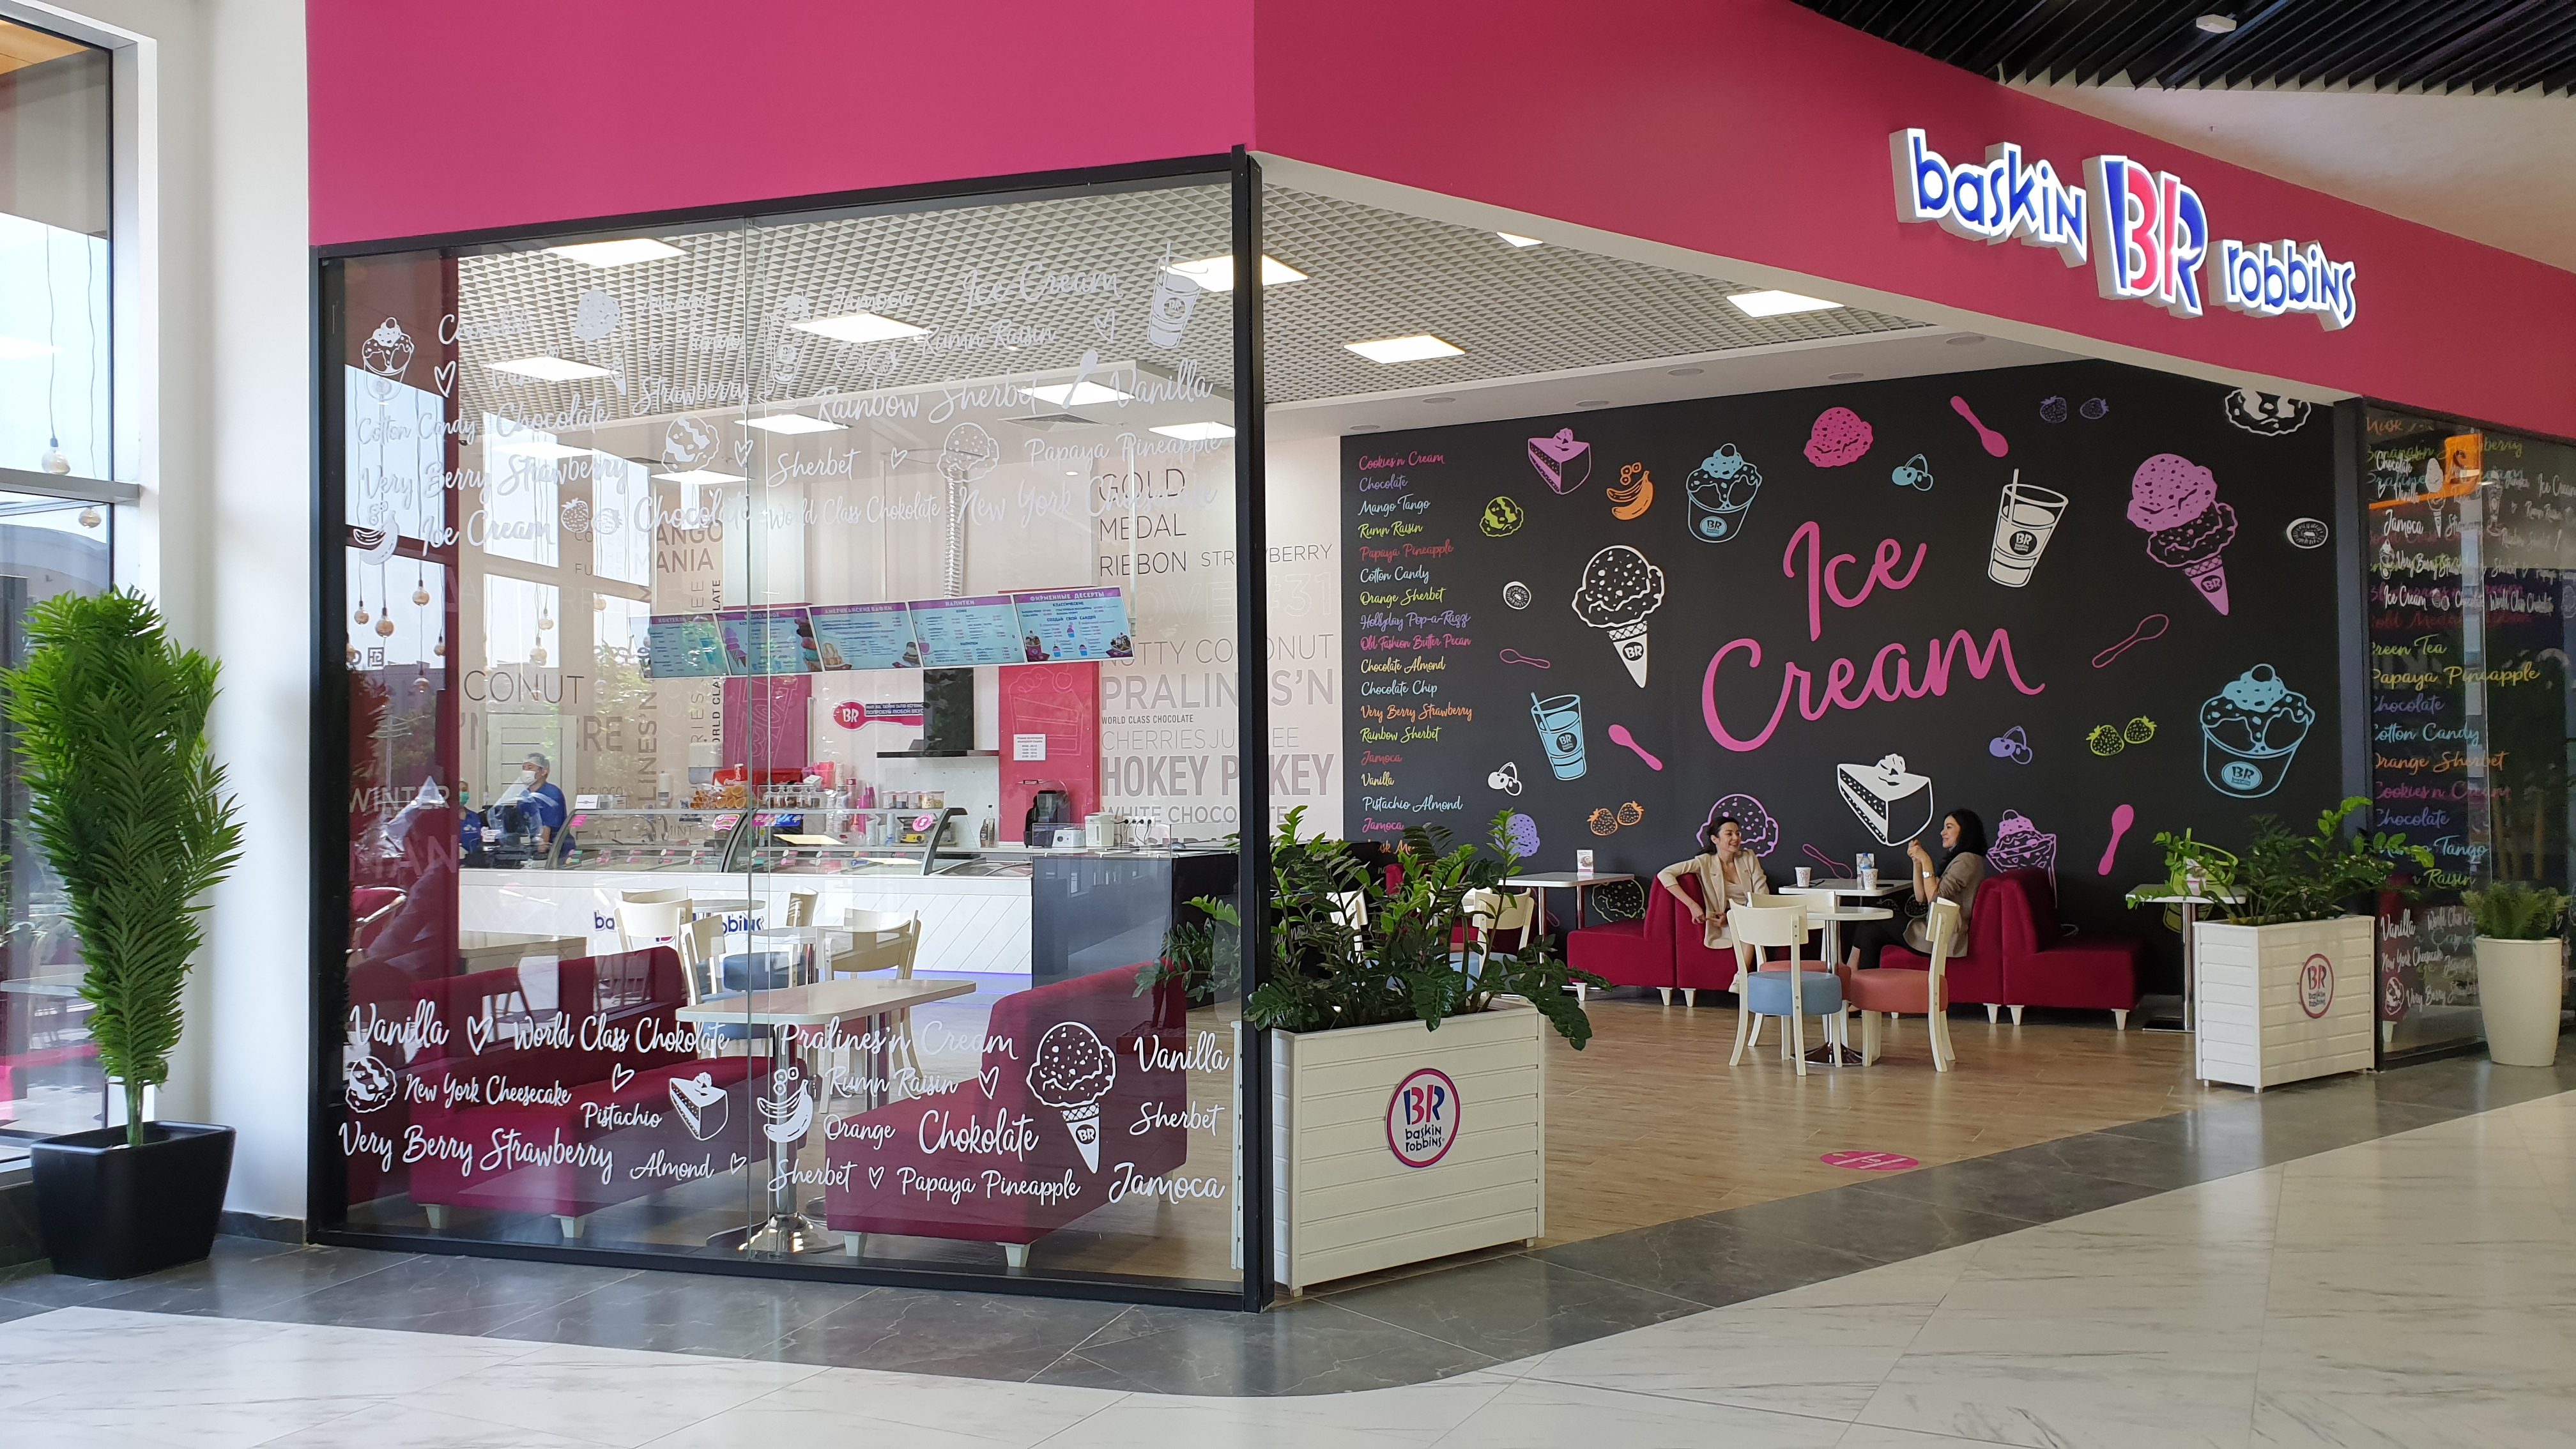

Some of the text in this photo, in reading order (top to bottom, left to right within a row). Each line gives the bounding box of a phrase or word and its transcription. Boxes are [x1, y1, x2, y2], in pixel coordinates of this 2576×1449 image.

[1907, 128, 2356, 329] baskin BR robbins
[963, 261, 1123, 314] Ice Cream
[632, 367, 749, 416] Strawberry
[1109, 358, 1213, 408] Vanilla
[812, 367, 1039, 430] Rainbow Sherbet
[357, 408, 475, 445] Cotton Candy
[496, 393, 610, 437] Chocolate
[1024, 419, 1222, 471] Papaya Pineapple
[1408, 450, 1445, 466] Cream
[360, 452, 629, 510] Very Berry Strawberry
[767, 447, 861, 488] Sherbet
[1098, 468, 1185, 502] GOLD
[1359, 473, 1409, 492] Chocolate
[634, 487, 750, 533] Chocolate
[824, 494, 862, 525] Class
[956, 485, 1007, 525] New
[1017, 479, 1074, 528] York
[1358, 494, 1430, 517] Mango Tango
[422, 514, 459, 556] Ice
[467, 509, 555, 547] Cream
[1099, 513, 1187, 542] MEDAL
[1391, 521, 1423, 537] Raisin
[1706, 519, 1722, 530] BR
[2384, 509, 2424, 538] Jamoca
[1359, 539, 1454, 563] Papaya Pineapple
[2016, 533, 2032, 546] BR
[1200, 544, 1333, 567] STRBERRY
[1360, 565, 1429, 584] Cotton Candy
[1783, 521, 1927, 641] Ice
[2202, 578, 2221, 592] BR
[1030, 594, 1071, 602] ФИРМЕННЫЕ
[1360, 586, 1446, 608] Orange Sherbet
[2399, 585, 2428, 611] Cream
[1360, 633, 1471, 651] Old Fashion Butter Pecan
[1625, 645, 1643, 659] BR
[2414, 634, 2448, 655] Tea
[1361, 656, 1446, 674] Chocolate Almond
[2443, 661, 2540, 687] Pineapple
[1101, 668, 1333, 710] PRALINS'N
[1361, 679, 1438, 698] Chocolate Chip
[1702, 628, 2045, 752] Cream
[843, 708, 859, 723] BR
[1101, 714, 1193, 724] WORLD CLASS CHOCOLATE
[1360, 702, 1472, 723] Very Berry Strawberry
[1101, 727, 1300, 751] CHERRIES JUEE
[1360, 724, 1442, 744] Rainbow Sherbet
[1558, 734, 1572, 746] BR
[2423, 723, 2480, 746] Candy
[1361, 750, 1403, 766] Jamoca
[2433, 751, 2510, 772] Sherbet
[1101, 753, 1335, 797] HOKEY PKEY
[1361, 770, 1395, 787] Vanilla
[2231, 766, 2255, 780] BR
[349, 785, 450, 814] WINTER
[1362, 794, 1463, 813] Pistachio Almond
[1362, 817, 1405, 833] Jamoca
[2433, 834, 2490, 862] Tango
[2423, 868, 2476, 889] Raisin
[2381, 908, 2416, 942] Vanilla
[2308, 965, 2327, 990] BR
[349, 999, 449, 1046] Vanilla
[513, 1011, 729, 1059] World Class Chokolate
[921, 1016, 1018, 1061] Cream
[1133, 1030, 1229, 1073] Vanilla
[405, 1073, 572, 1108] New York Cheesecake
[893, 1065, 959, 1099] Raisin
[580, 1101, 663, 1131] Pistachio
[1129, 1101, 1225, 1137] Sherbet
[1403, 1084, 1445, 1125] BR
[823, 1113, 895, 1150] Orange
[918, 1109, 1039, 1162] Chokolate
[1078, 1128, 1096, 1142] BR
[1405, 1124, 1442, 1140] baskin
[1406, 1137, 1442, 1153] robbins
[338, 1121, 613, 1184] Very Berry Strawberry
[629, 1149, 714, 1181] Almond
[767, 1158, 857, 1193] Sherbet
[896, 1167, 1080, 1206] Papaya Pineapple
[1108, 1161, 1226, 1204] Jamoca
